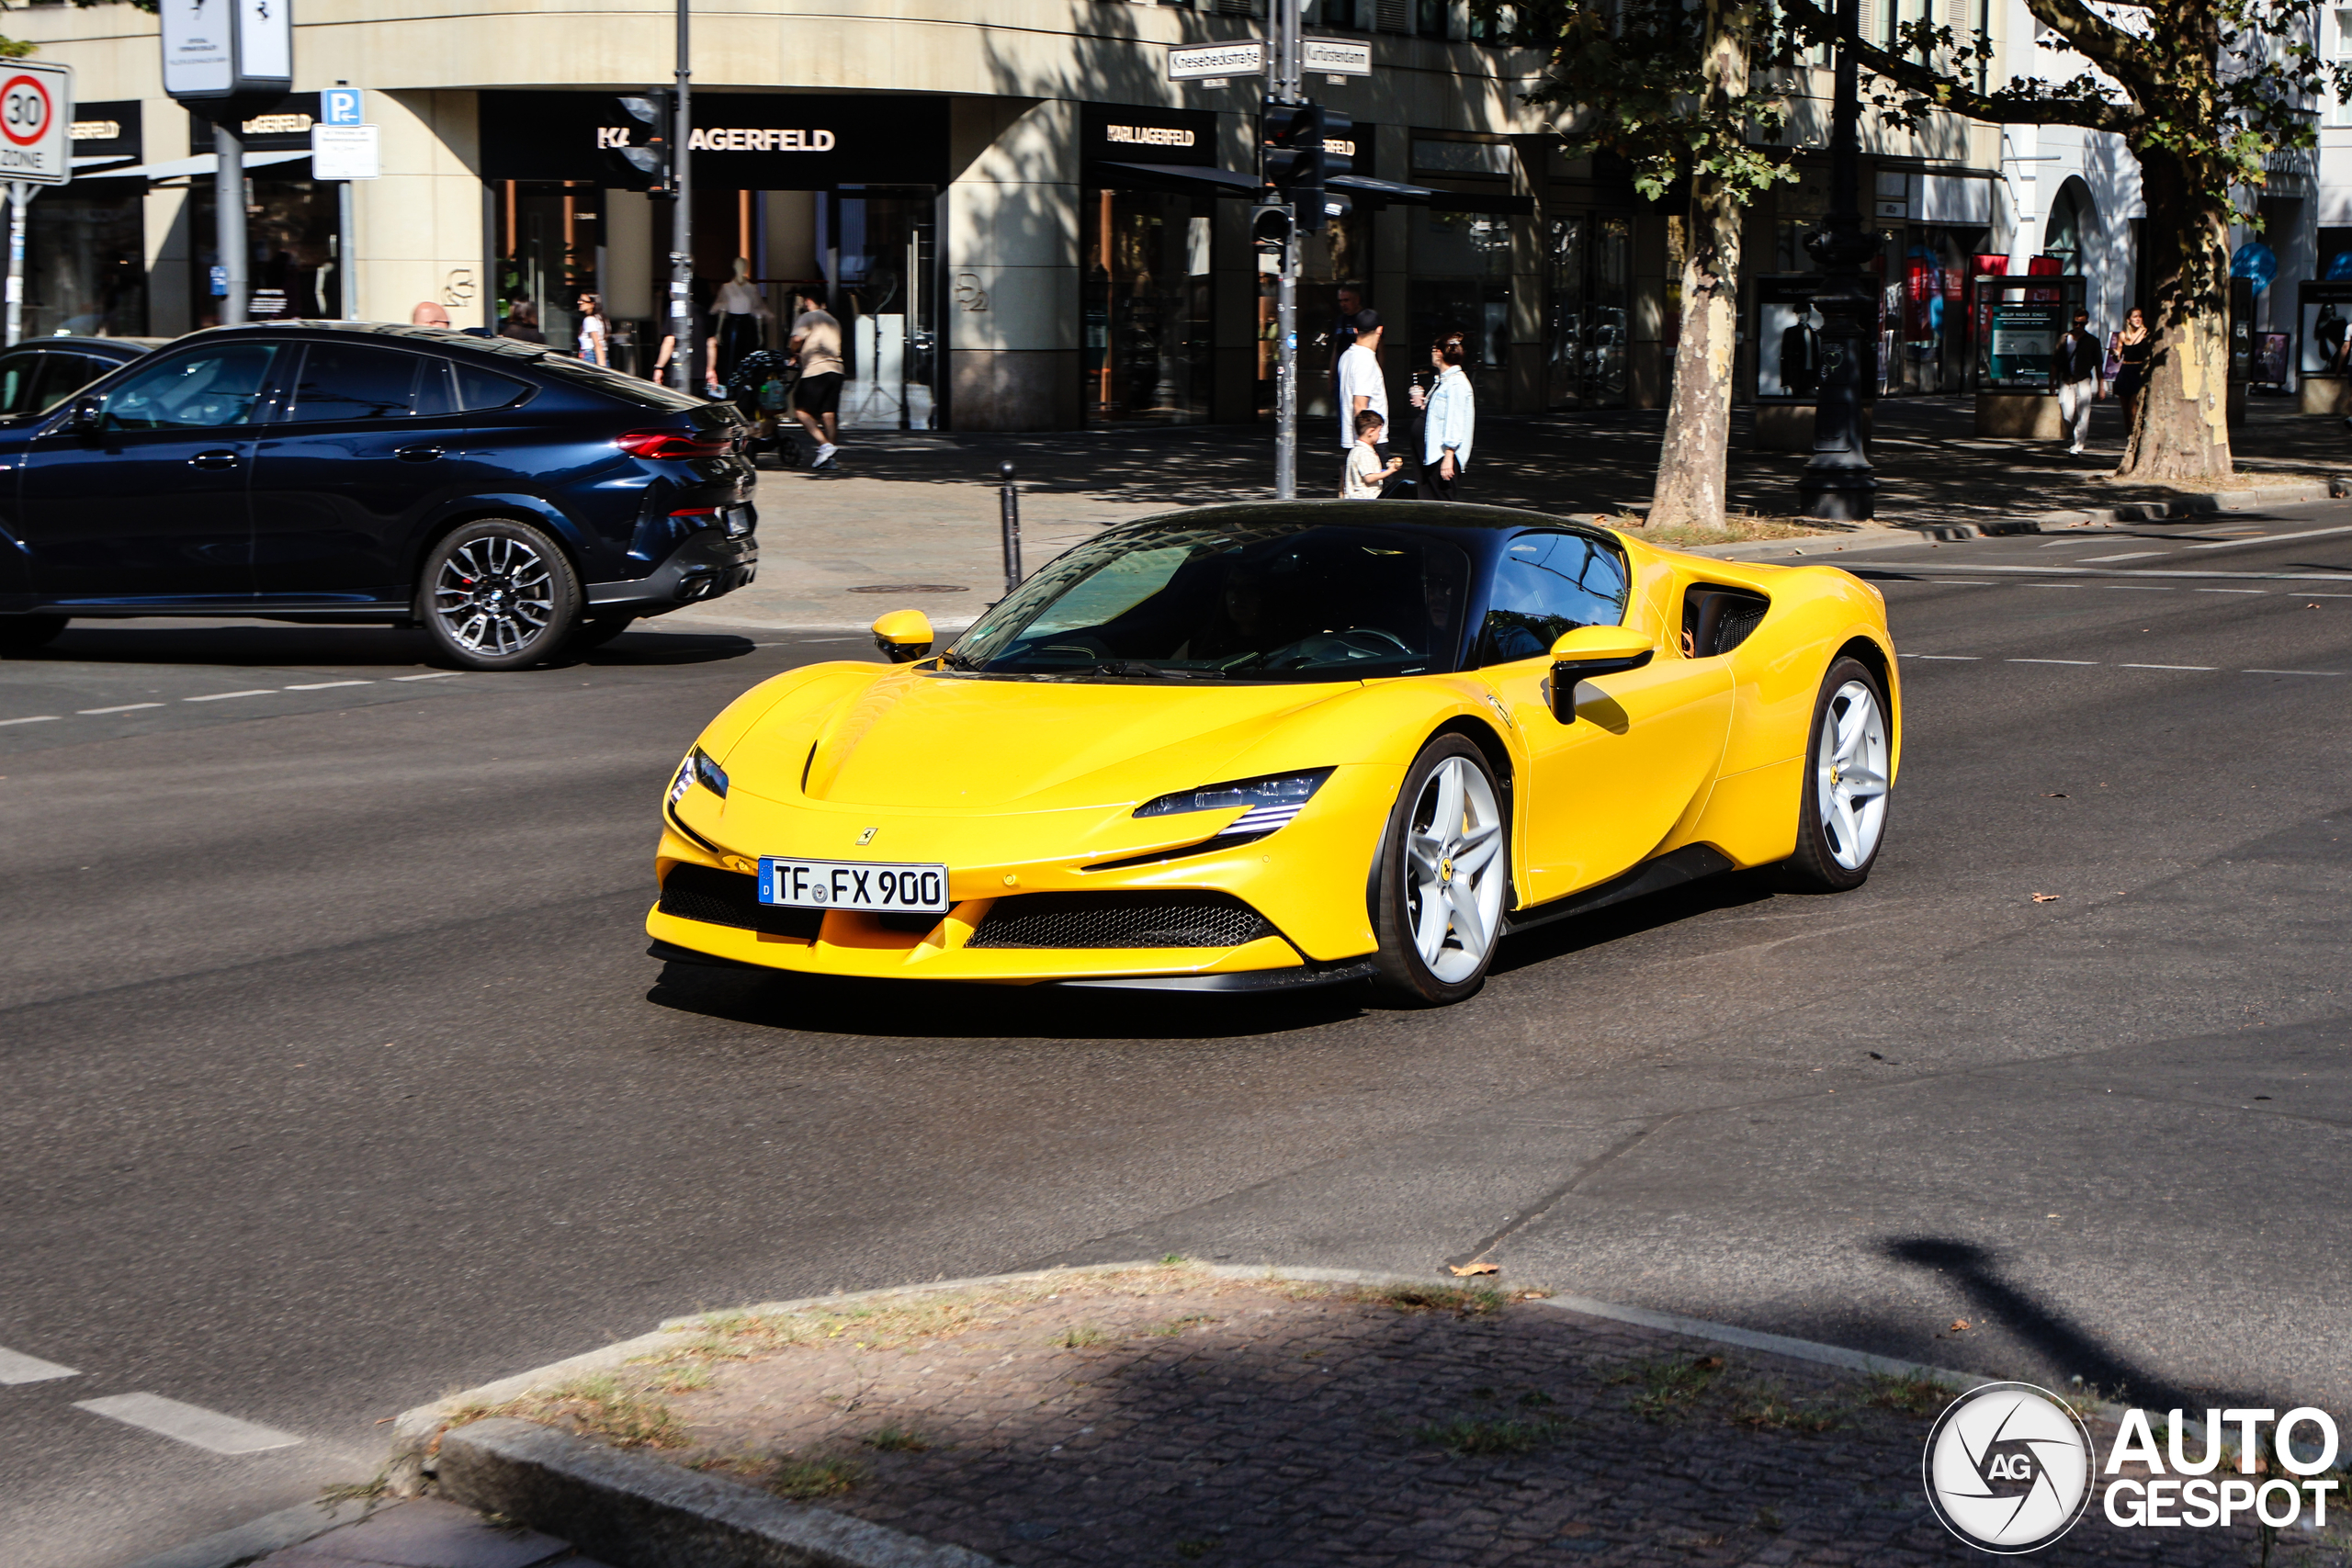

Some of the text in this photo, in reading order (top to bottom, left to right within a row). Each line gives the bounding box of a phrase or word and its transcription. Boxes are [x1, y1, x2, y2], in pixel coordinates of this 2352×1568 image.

[1171, 48, 1260, 69] Knesebeckstraße
[6, 95, 40, 126] 30
[331, 93, 355, 121] P
[687, 128, 835, 152] AGERFELD
[1107, 125, 1194, 147] KARL LAGERFELD
[1, 150, 43, 169] ZONE
[763, 886, 770, 896] D
[775, 865, 941, 905] TF FX 900
